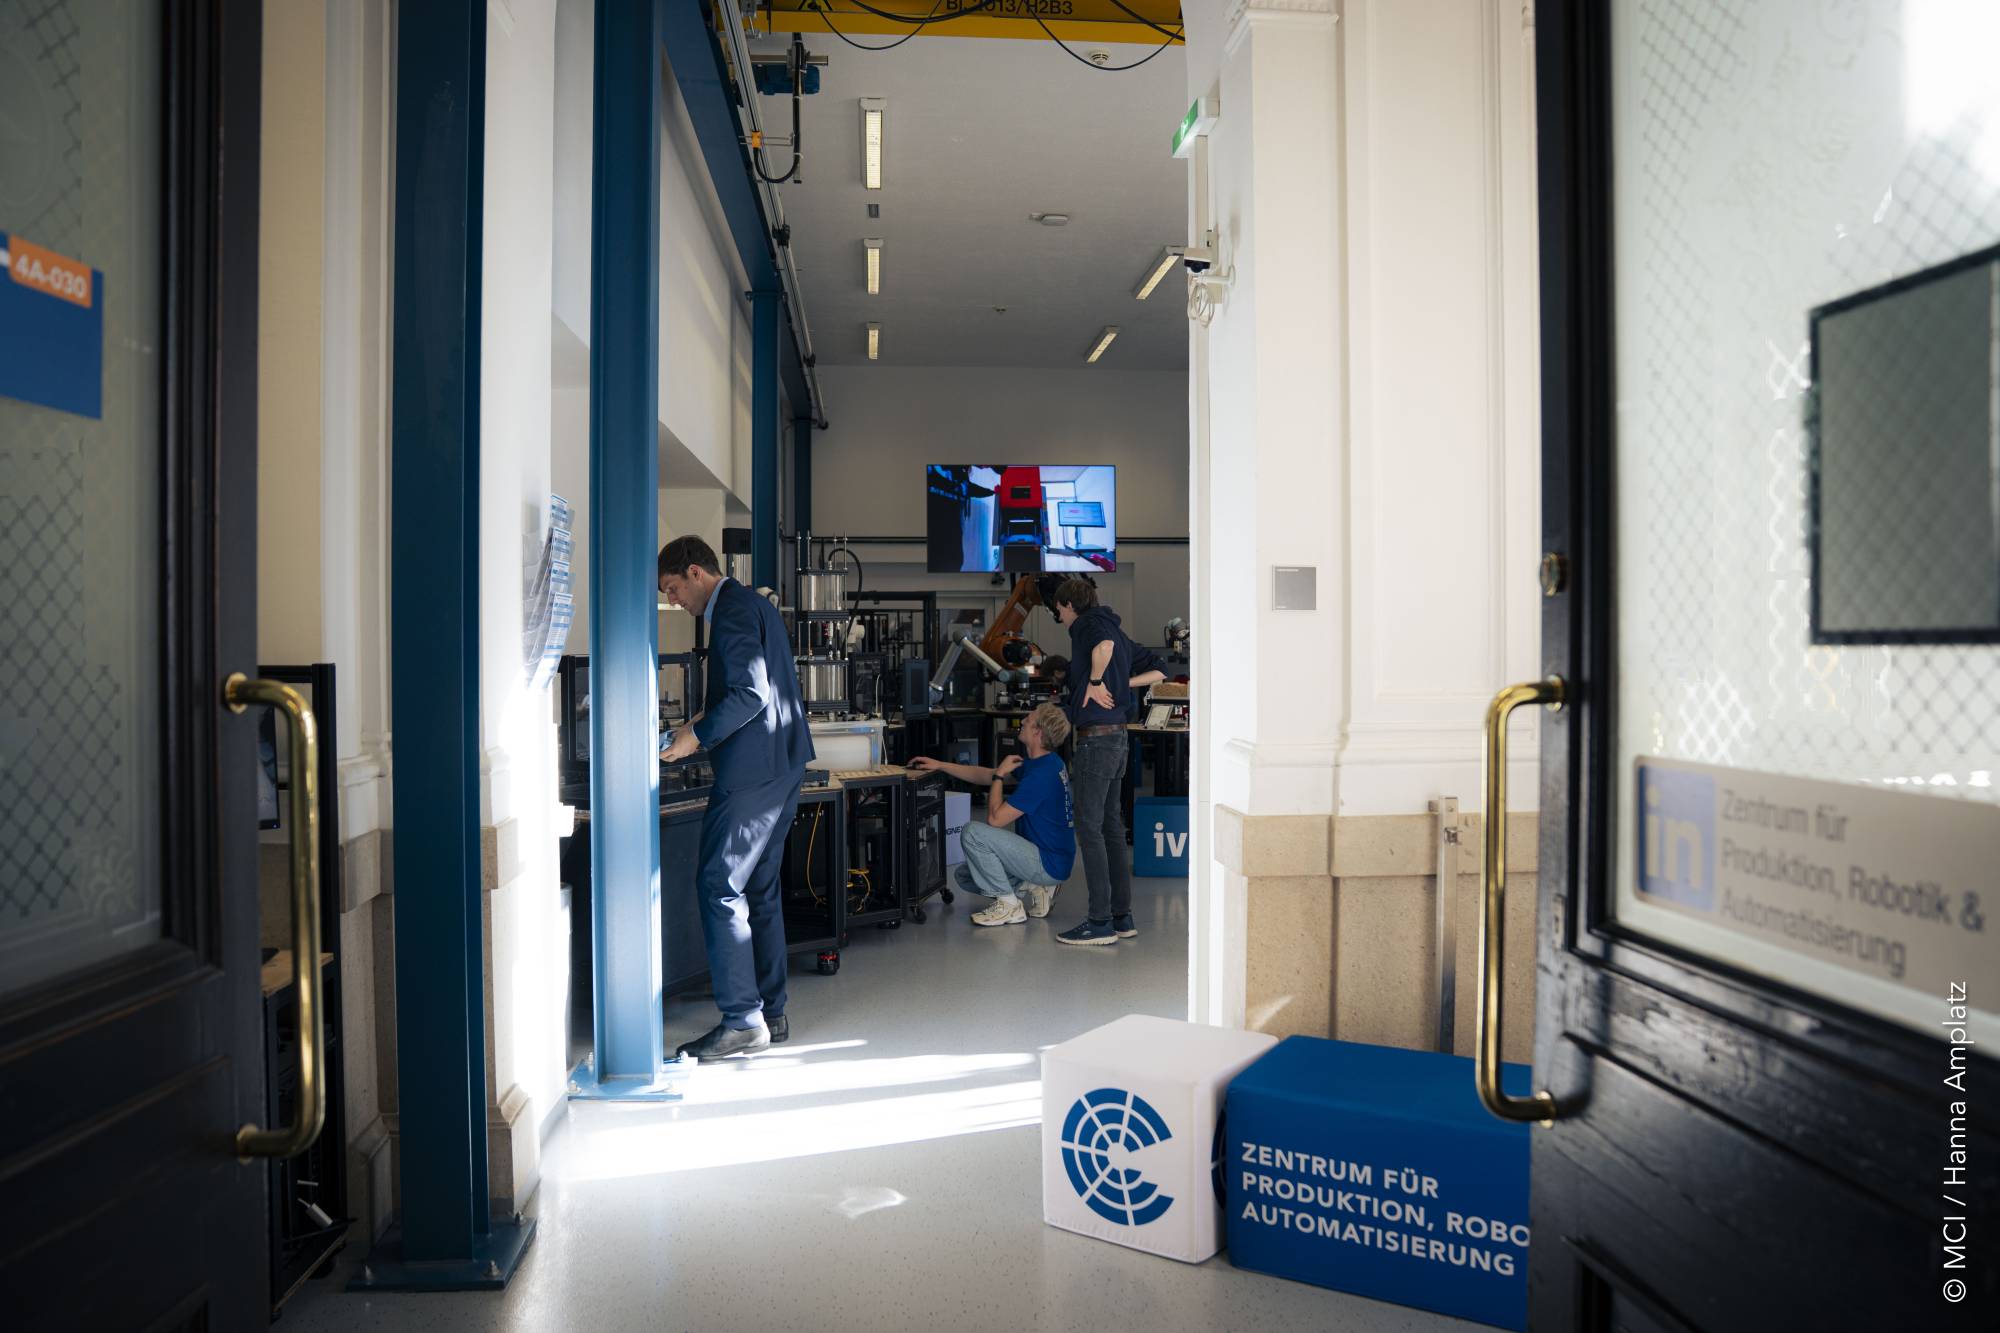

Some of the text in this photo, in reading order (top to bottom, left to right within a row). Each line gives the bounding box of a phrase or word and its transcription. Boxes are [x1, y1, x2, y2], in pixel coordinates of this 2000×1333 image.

[16, 254, 87, 299] 4A-030
[1722, 788, 1849, 843] Zentrum für
[1721, 838, 1985, 932] Produktion, Robotik &
[1720, 889, 1907, 979] Automatisierung
[1241, 1142, 1439, 1199] ZENTRUM FÜR
[1241, 1201, 1515, 1276] AUTOMATISIERUNG
[1242, 1172, 1530, 1247] PRODUKTION, ROBO
